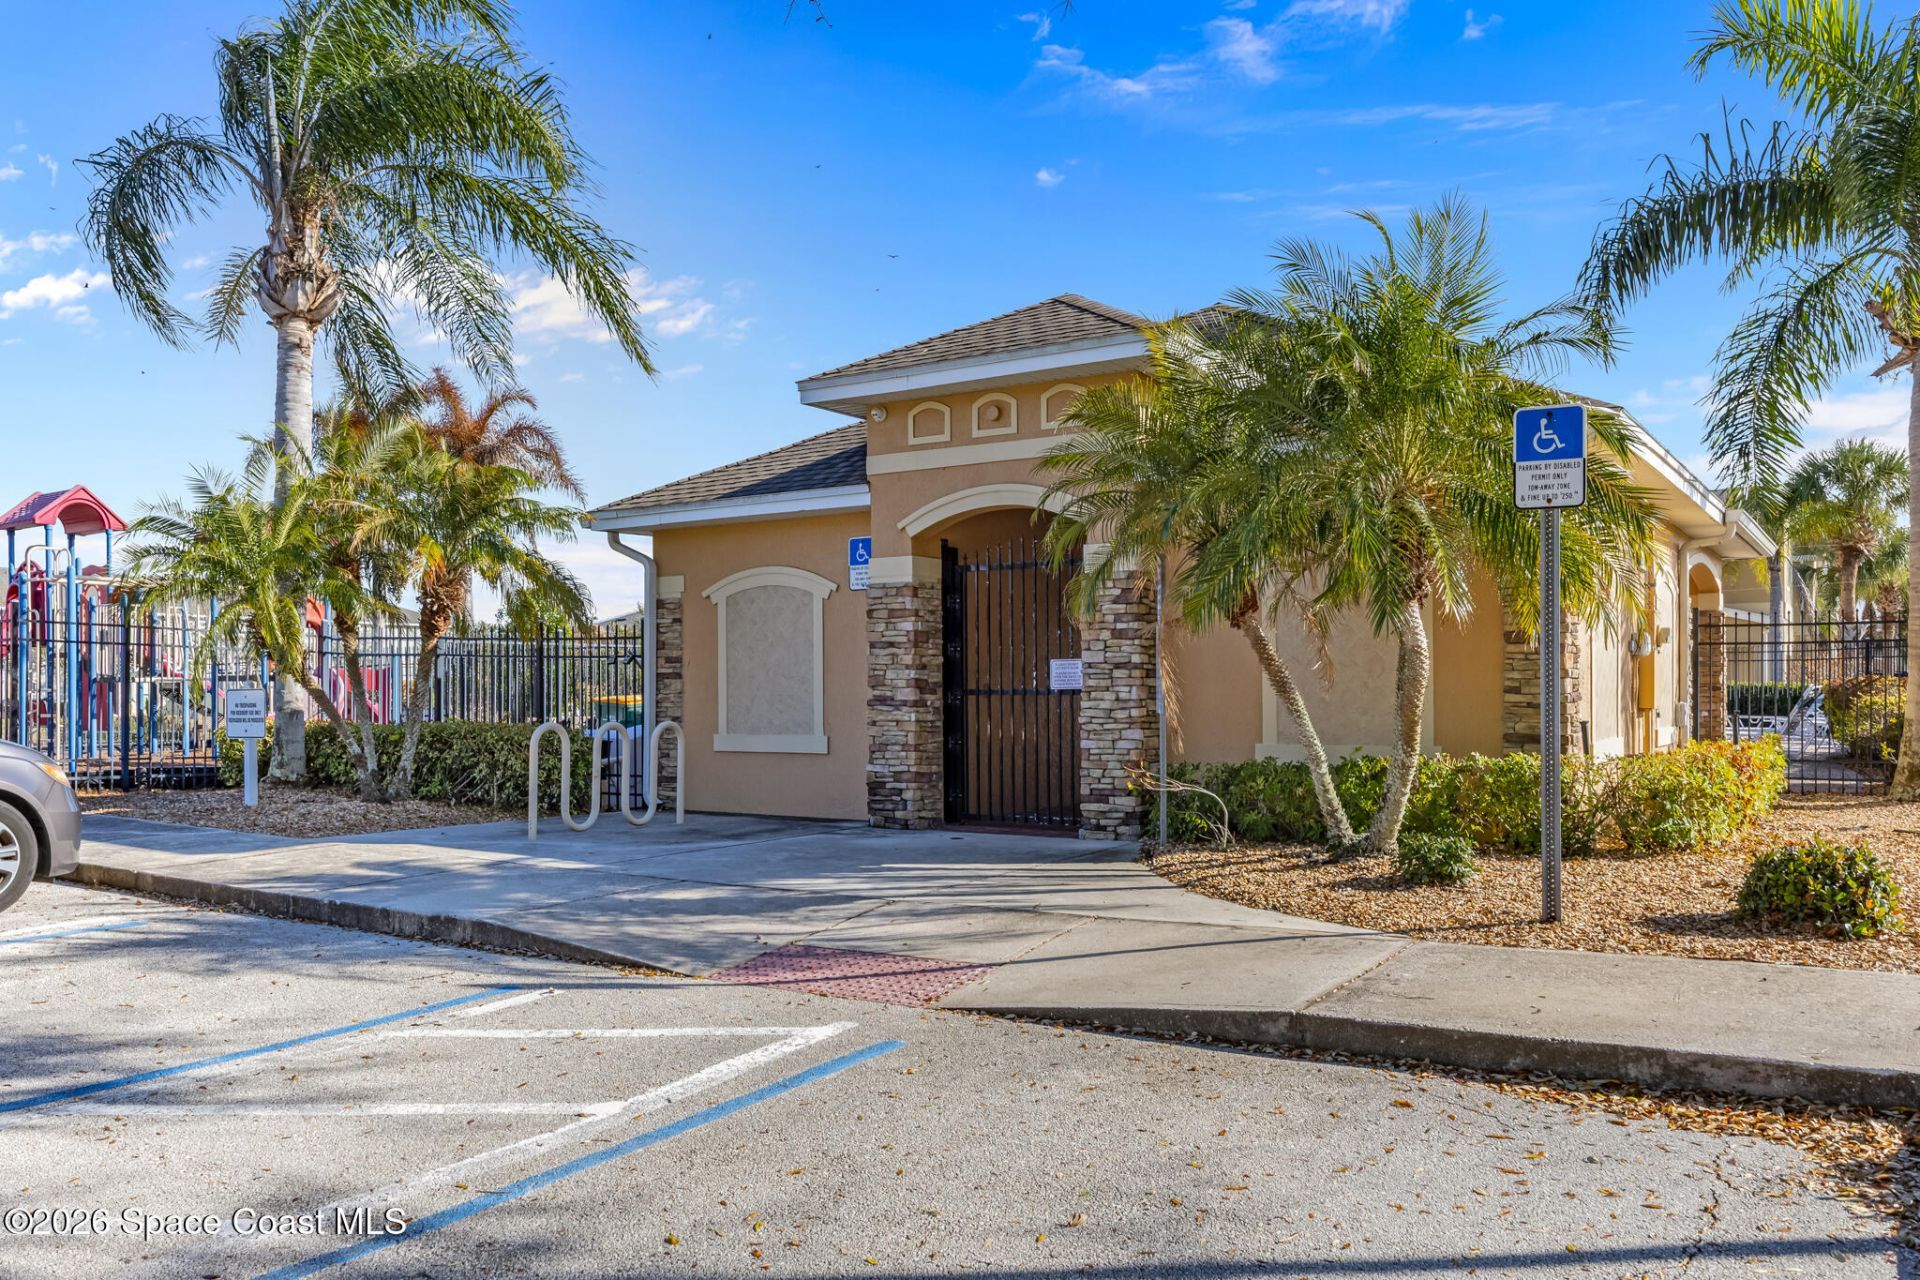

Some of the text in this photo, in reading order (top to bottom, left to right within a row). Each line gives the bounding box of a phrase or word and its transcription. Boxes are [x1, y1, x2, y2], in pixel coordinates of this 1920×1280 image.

[1553, 461, 1581, 470] DISABLED
[1531, 472, 1568, 481] PERMIT ONLY
[1528, 482, 1571, 491] TOW-AWAY ZONE
[1541, 493, 1550, 501] UP
